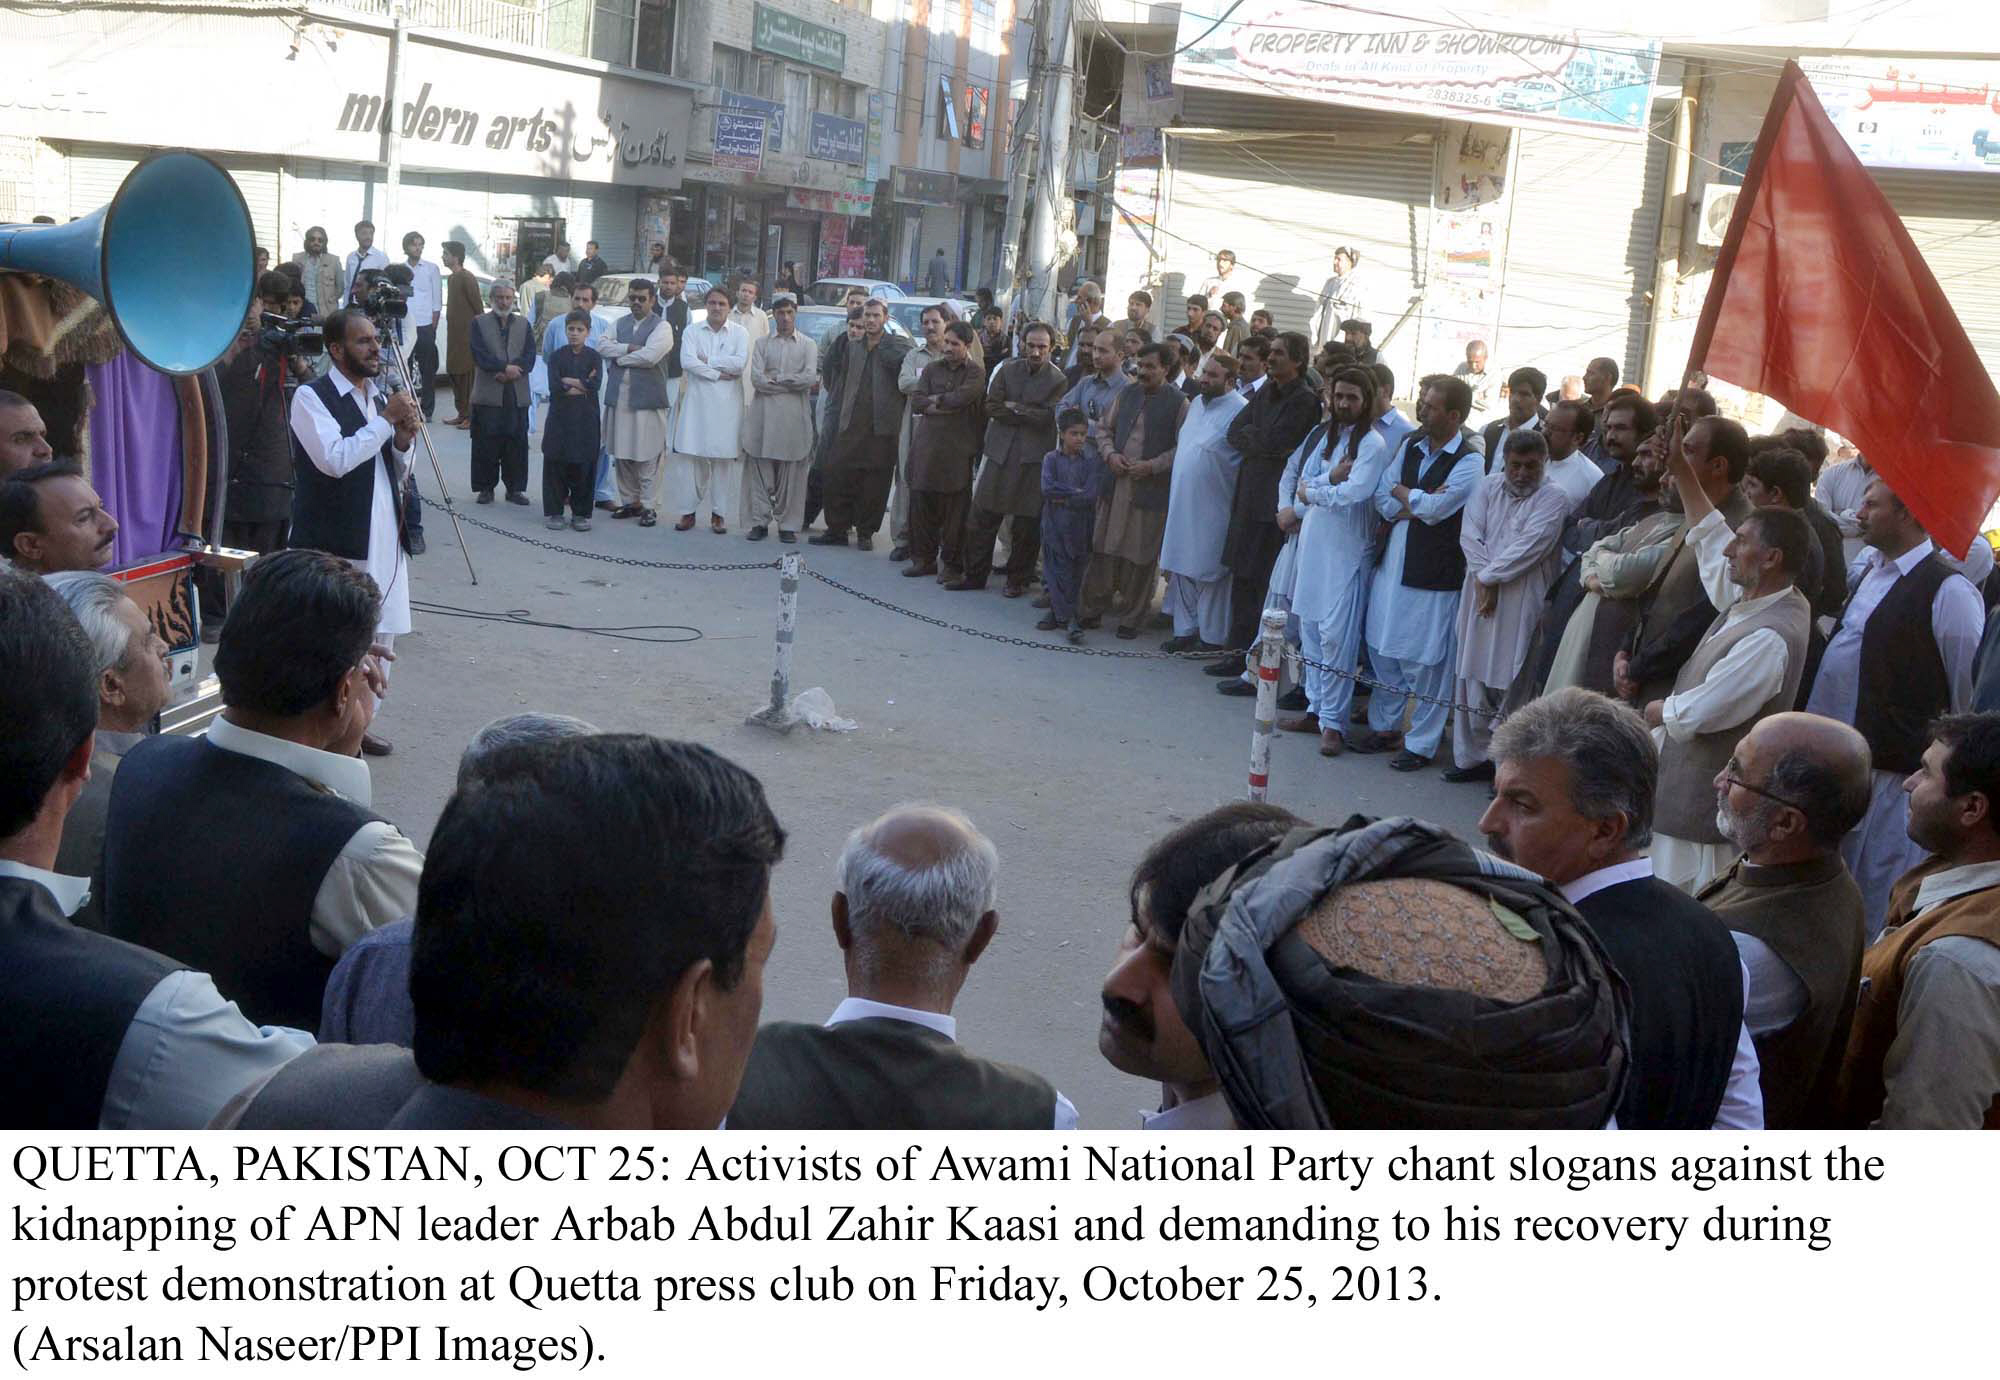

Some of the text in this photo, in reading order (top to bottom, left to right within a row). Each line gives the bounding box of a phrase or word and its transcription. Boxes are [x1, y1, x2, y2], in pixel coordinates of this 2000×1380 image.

[1249, 32, 1567, 55] PROPERTY INN & SHOWROOM
[1305, 61, 1489, 76] Deals in All Kind of Property
[485, 107, 557, 152] arts
[622, 127, 677, 167] ماڈرن
